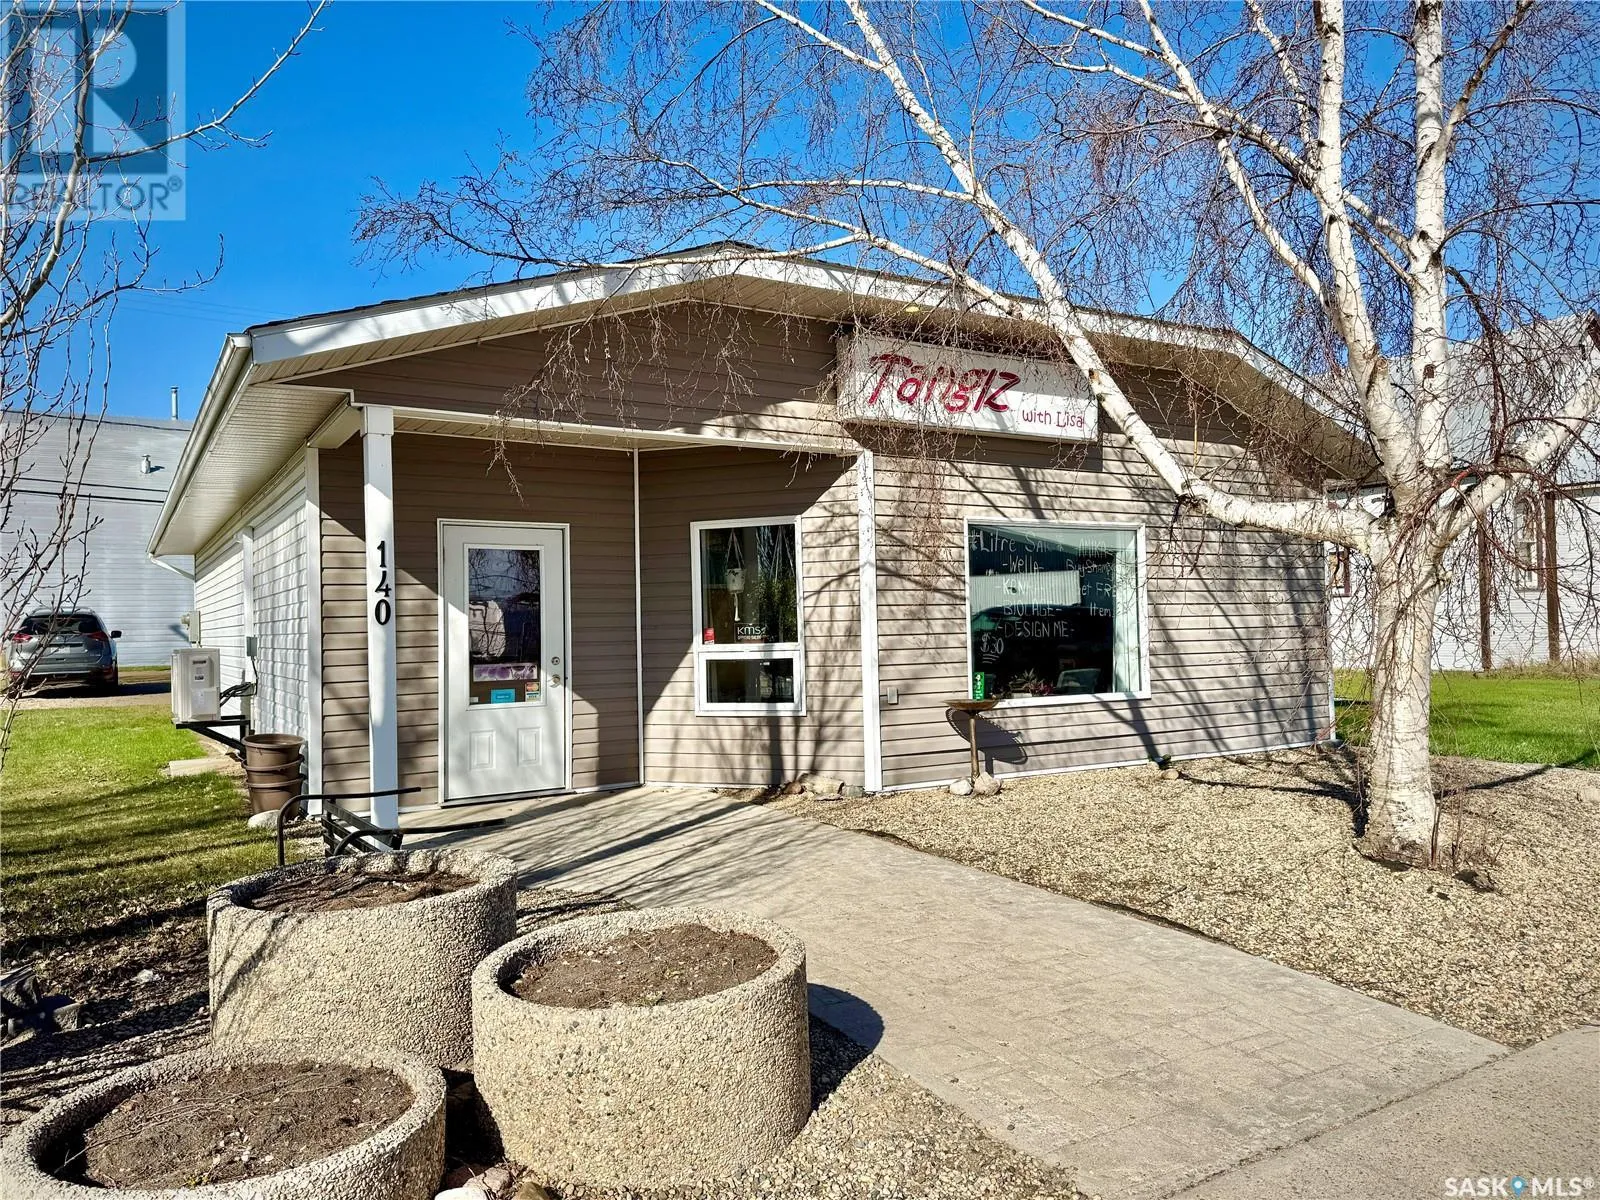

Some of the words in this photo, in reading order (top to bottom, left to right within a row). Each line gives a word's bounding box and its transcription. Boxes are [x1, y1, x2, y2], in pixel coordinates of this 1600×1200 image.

[1022, 408, 1052, 425] with
[1055, 411, 1084, 429] Lisa
[374, 540, 392, 626] 140
